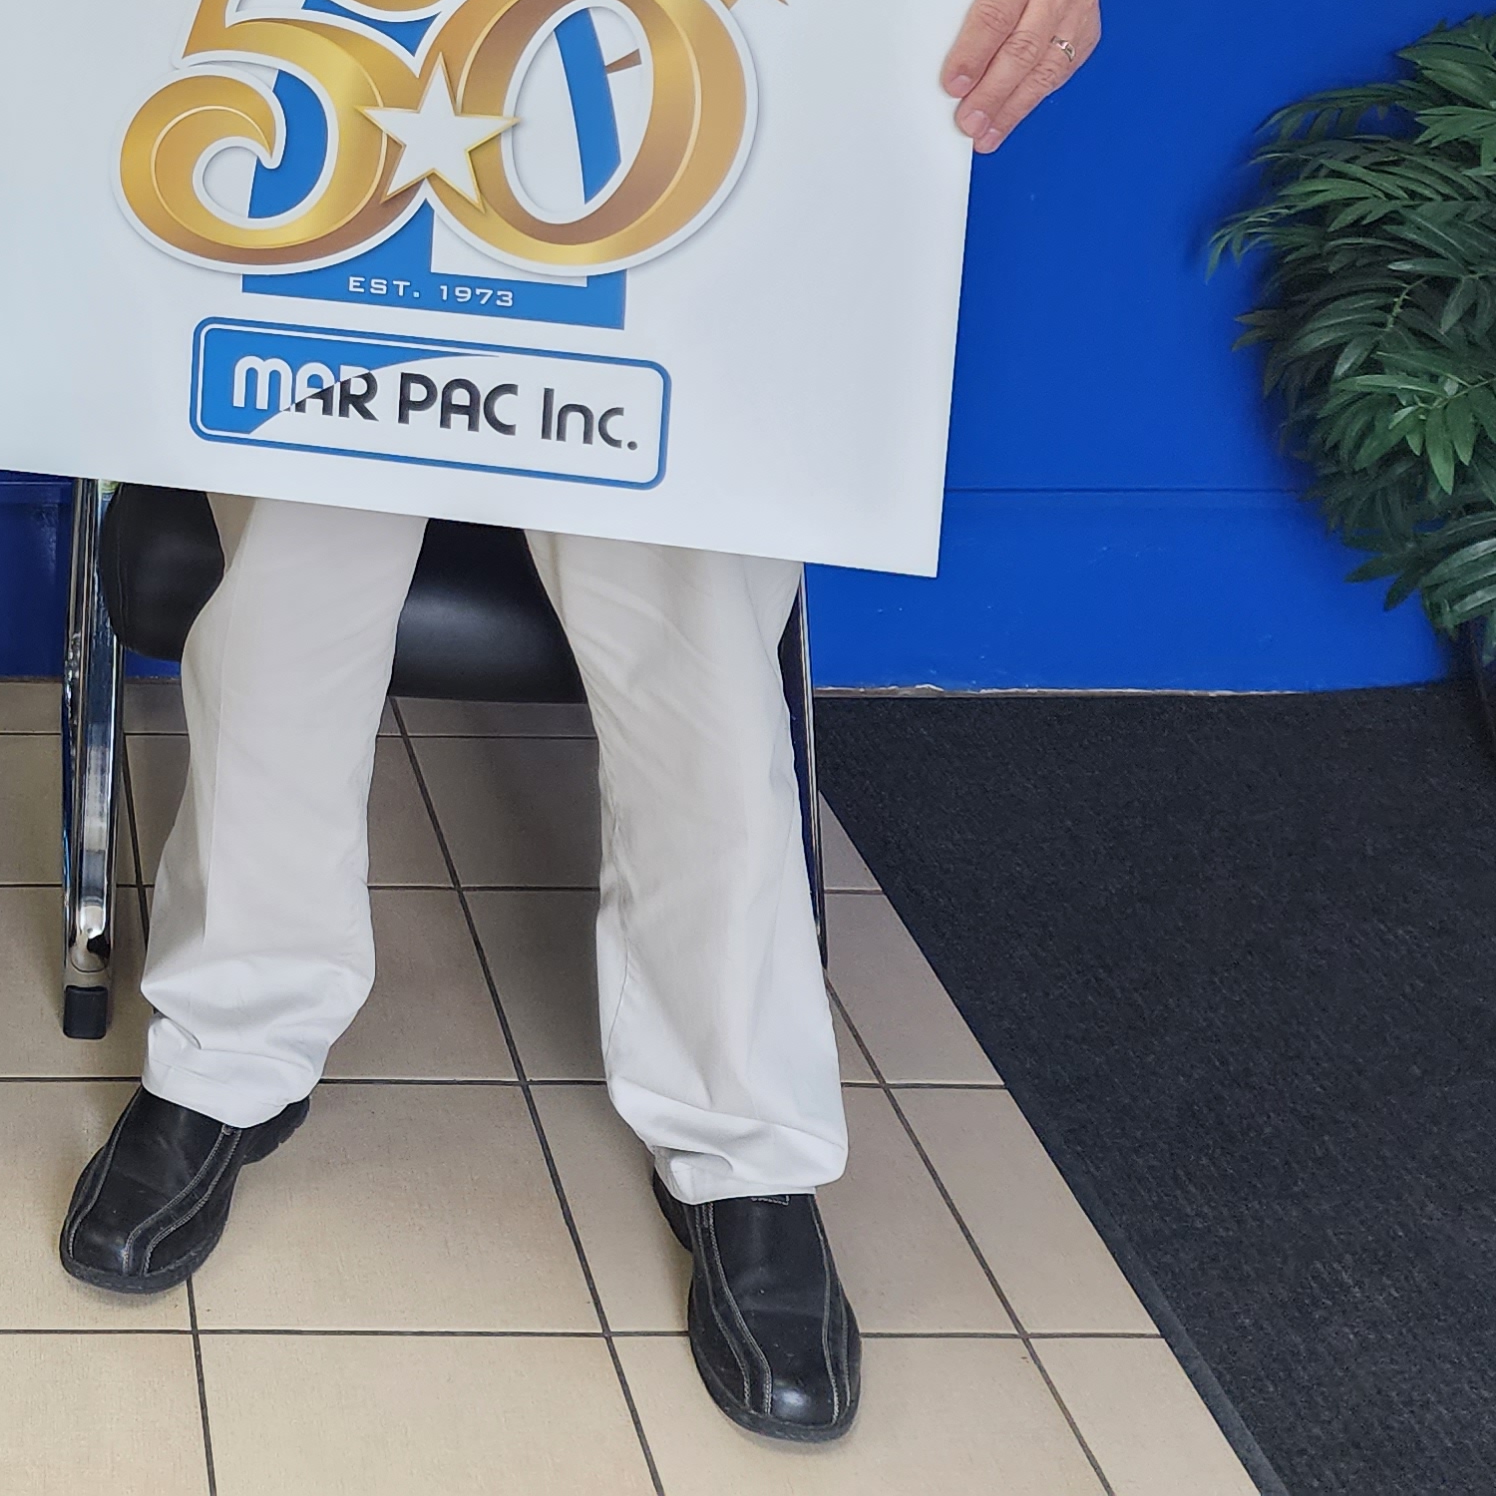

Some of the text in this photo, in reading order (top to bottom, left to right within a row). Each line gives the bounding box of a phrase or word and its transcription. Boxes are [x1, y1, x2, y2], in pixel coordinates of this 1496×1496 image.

[348, 276, 515, 308] EST. 1973
[233, 355, 639, 452] MAR PAC Inc.
